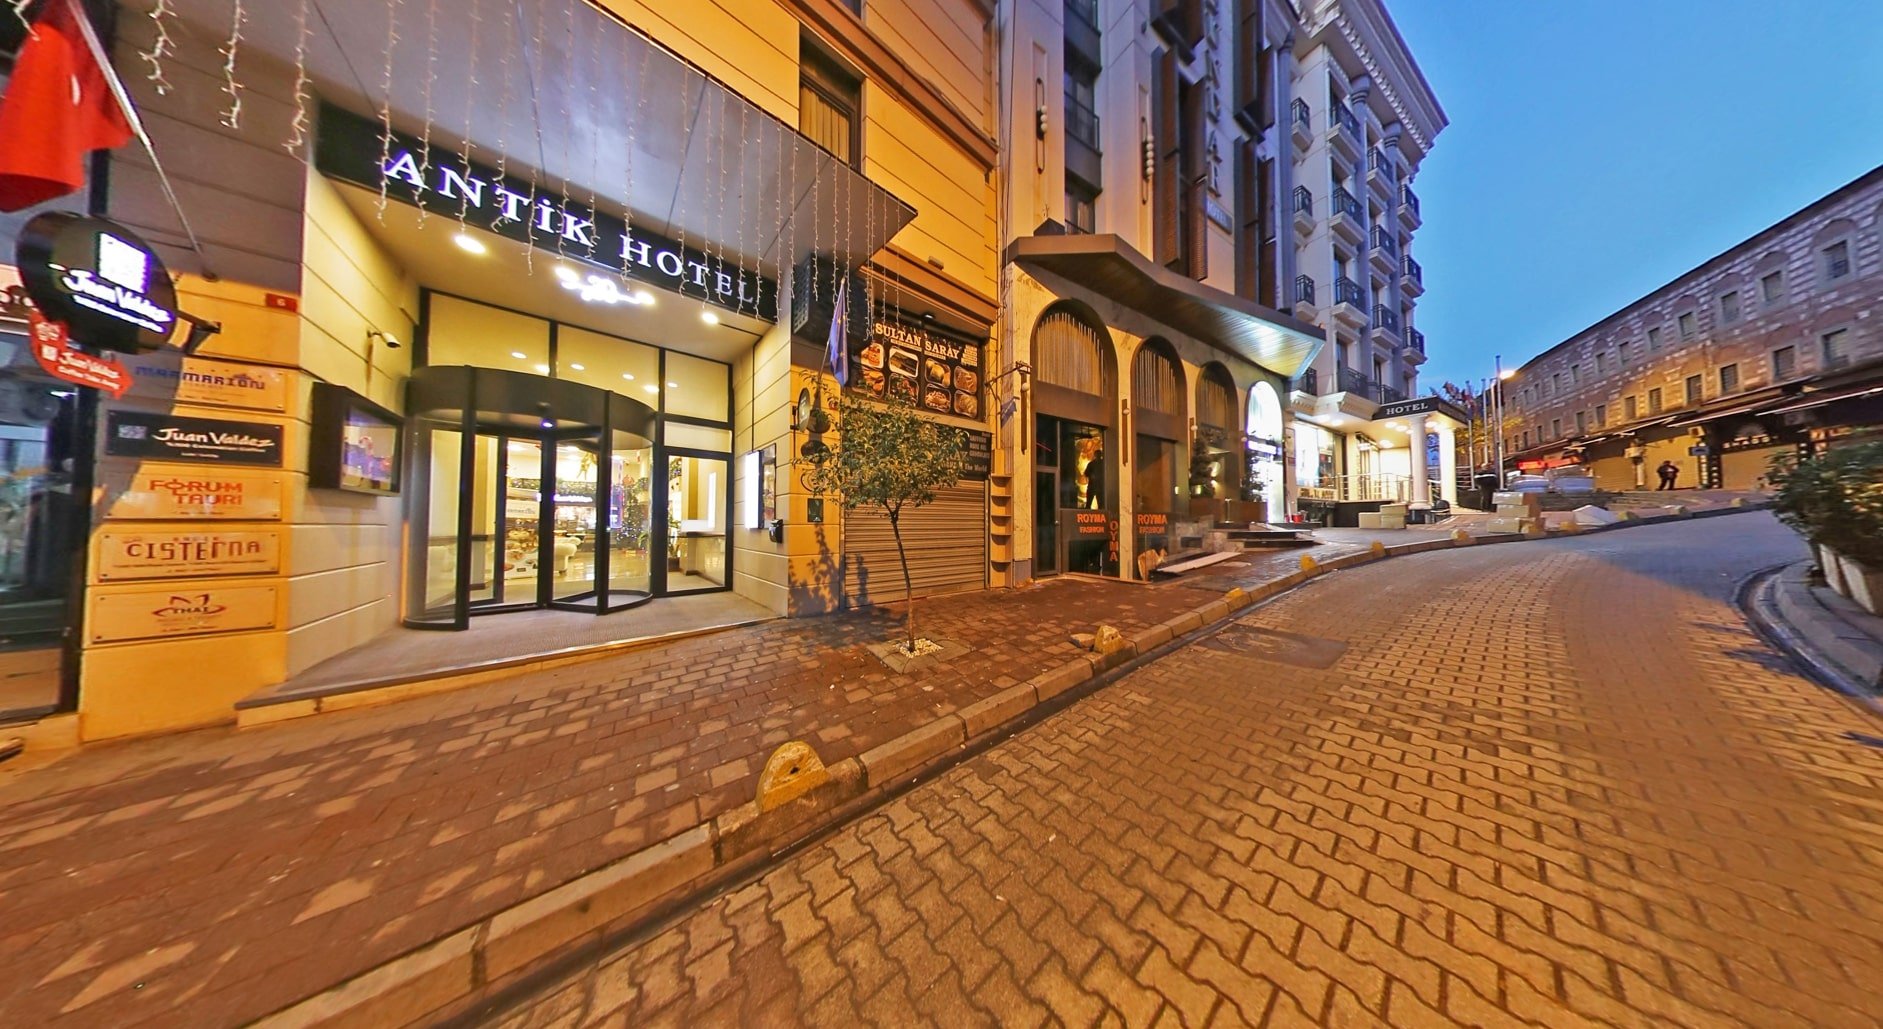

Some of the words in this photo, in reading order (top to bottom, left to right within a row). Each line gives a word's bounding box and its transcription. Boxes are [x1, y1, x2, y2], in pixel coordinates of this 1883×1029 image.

[619, 234, 753, 303] HOTEL
[875, 322, 922, 347] SULTAN
[924, 340, 960, 360] SARAY
[1386, 402, 1428, 415] HOTEL
[152, 428, 208, 442] Juan
[209, 432, 275, 447] Valdez
[150, 479, 243, 493] FORUM
[175, 494, 243, 505] TAURI
[1077, 514, 1106, 523] ROYMA
[1137, 514, 1168, 524] ROYMA
